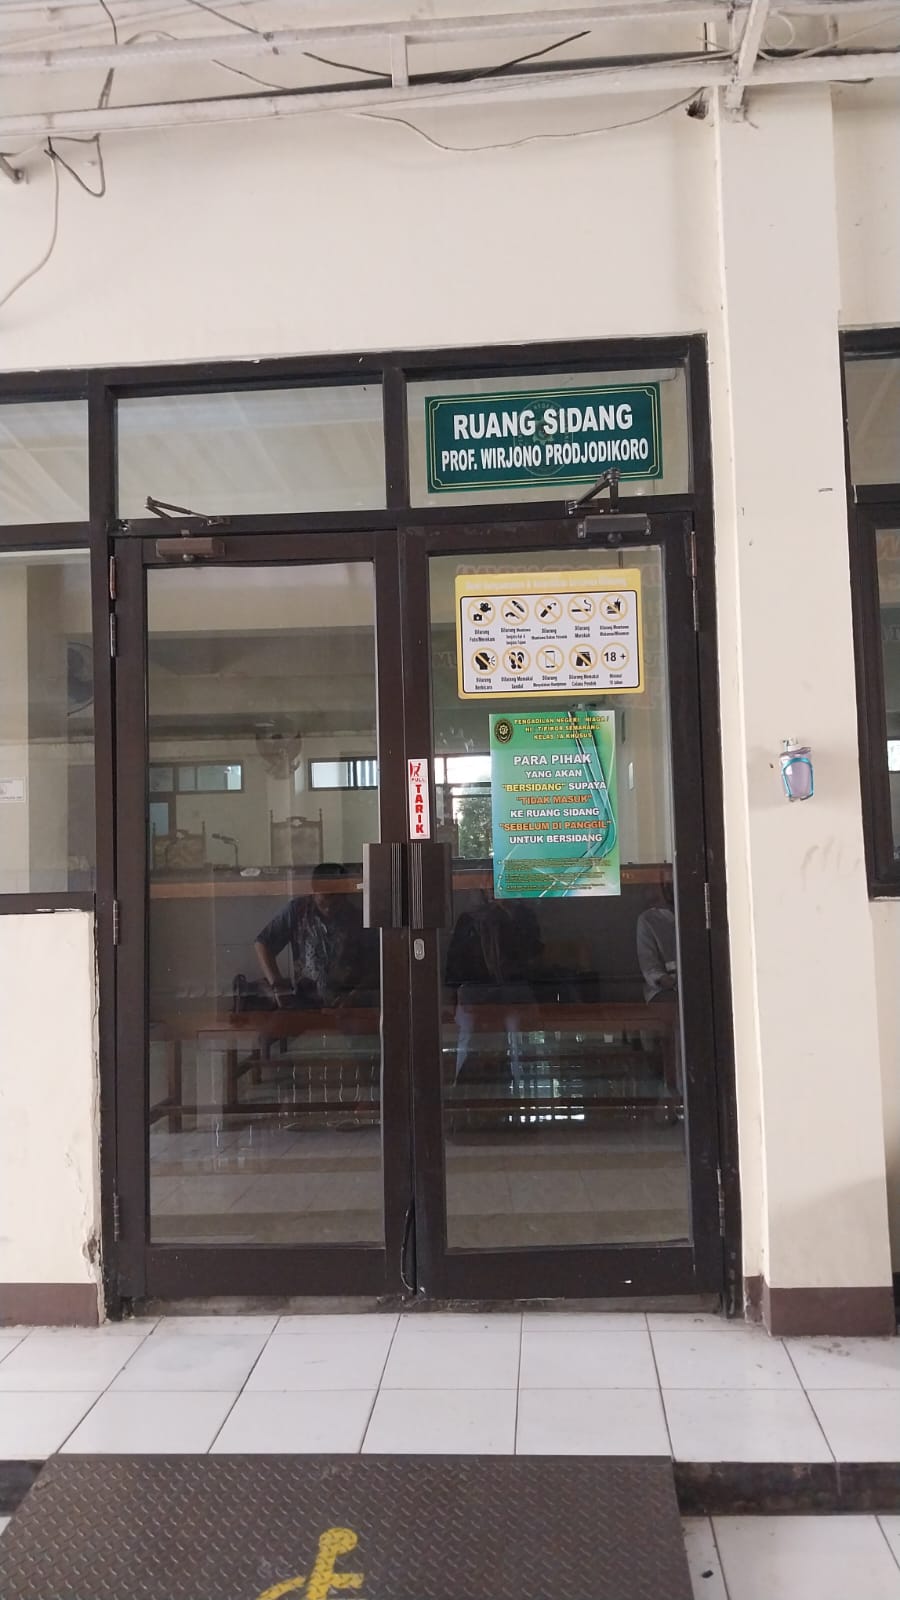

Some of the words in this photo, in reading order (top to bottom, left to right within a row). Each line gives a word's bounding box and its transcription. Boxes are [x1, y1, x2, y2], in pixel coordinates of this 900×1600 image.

[453, 409, 535, 440] RUANG
[543, 403, 633, 435] SIDANG
[441, 448, 478, 472] PROF.
[481, 445, 542, 470] WIRJONO
[545, 437, 649, 466] PRODJODIKORO
[603, 651, 617, 662] 18
[513, 754, 548, 766] PARA
[551, 753, 592, 765] PIHAK
[525, 770, 552, 779] YANG
[554, 769, 582, 778] AKAN
[502, 783, 565, 792] "BERSIDANG"
[568, 781, 606, 790] SUPAYA
[516, 796, 551, 805] "TIDAK
[553, 794, 592, 804] MASUK"
[415, 784, 424, 833] TARIK
[510, 810, 524, 818] KE
[526, 809, 561, 817] RUANG
[563, 807, 600, 816] SIDANG
[500, 822, 549, 831] "SEBELUM
[552, 821, 562, 830] DI
[564, 820, 612, 829] PANGGIL"
[509, 835, 543, 844] UNTUK
[546, 834, 603, 843] BERSIDANG
